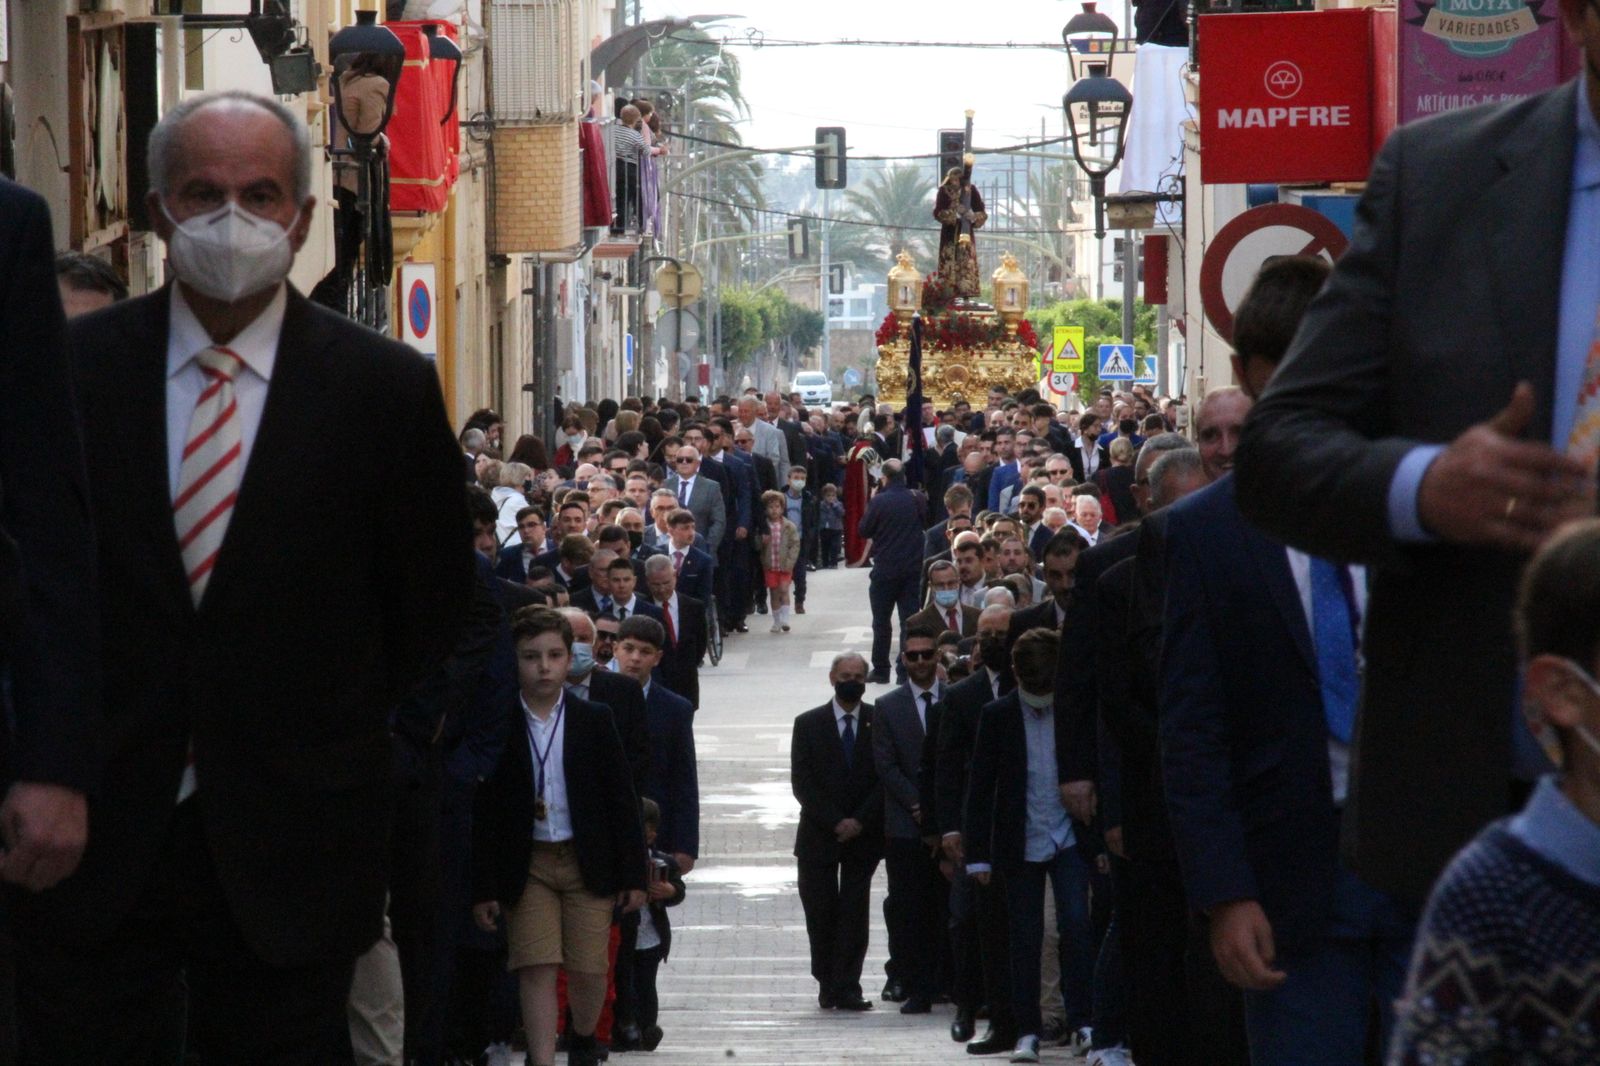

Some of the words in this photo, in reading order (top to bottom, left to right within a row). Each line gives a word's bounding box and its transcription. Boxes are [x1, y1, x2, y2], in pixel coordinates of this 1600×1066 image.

[1451, 0, 1513, 11] MOYA
[1439, 18, 1520, 36] VARIEDADES
[1218, 106, 1350, 128] MAPFRE
